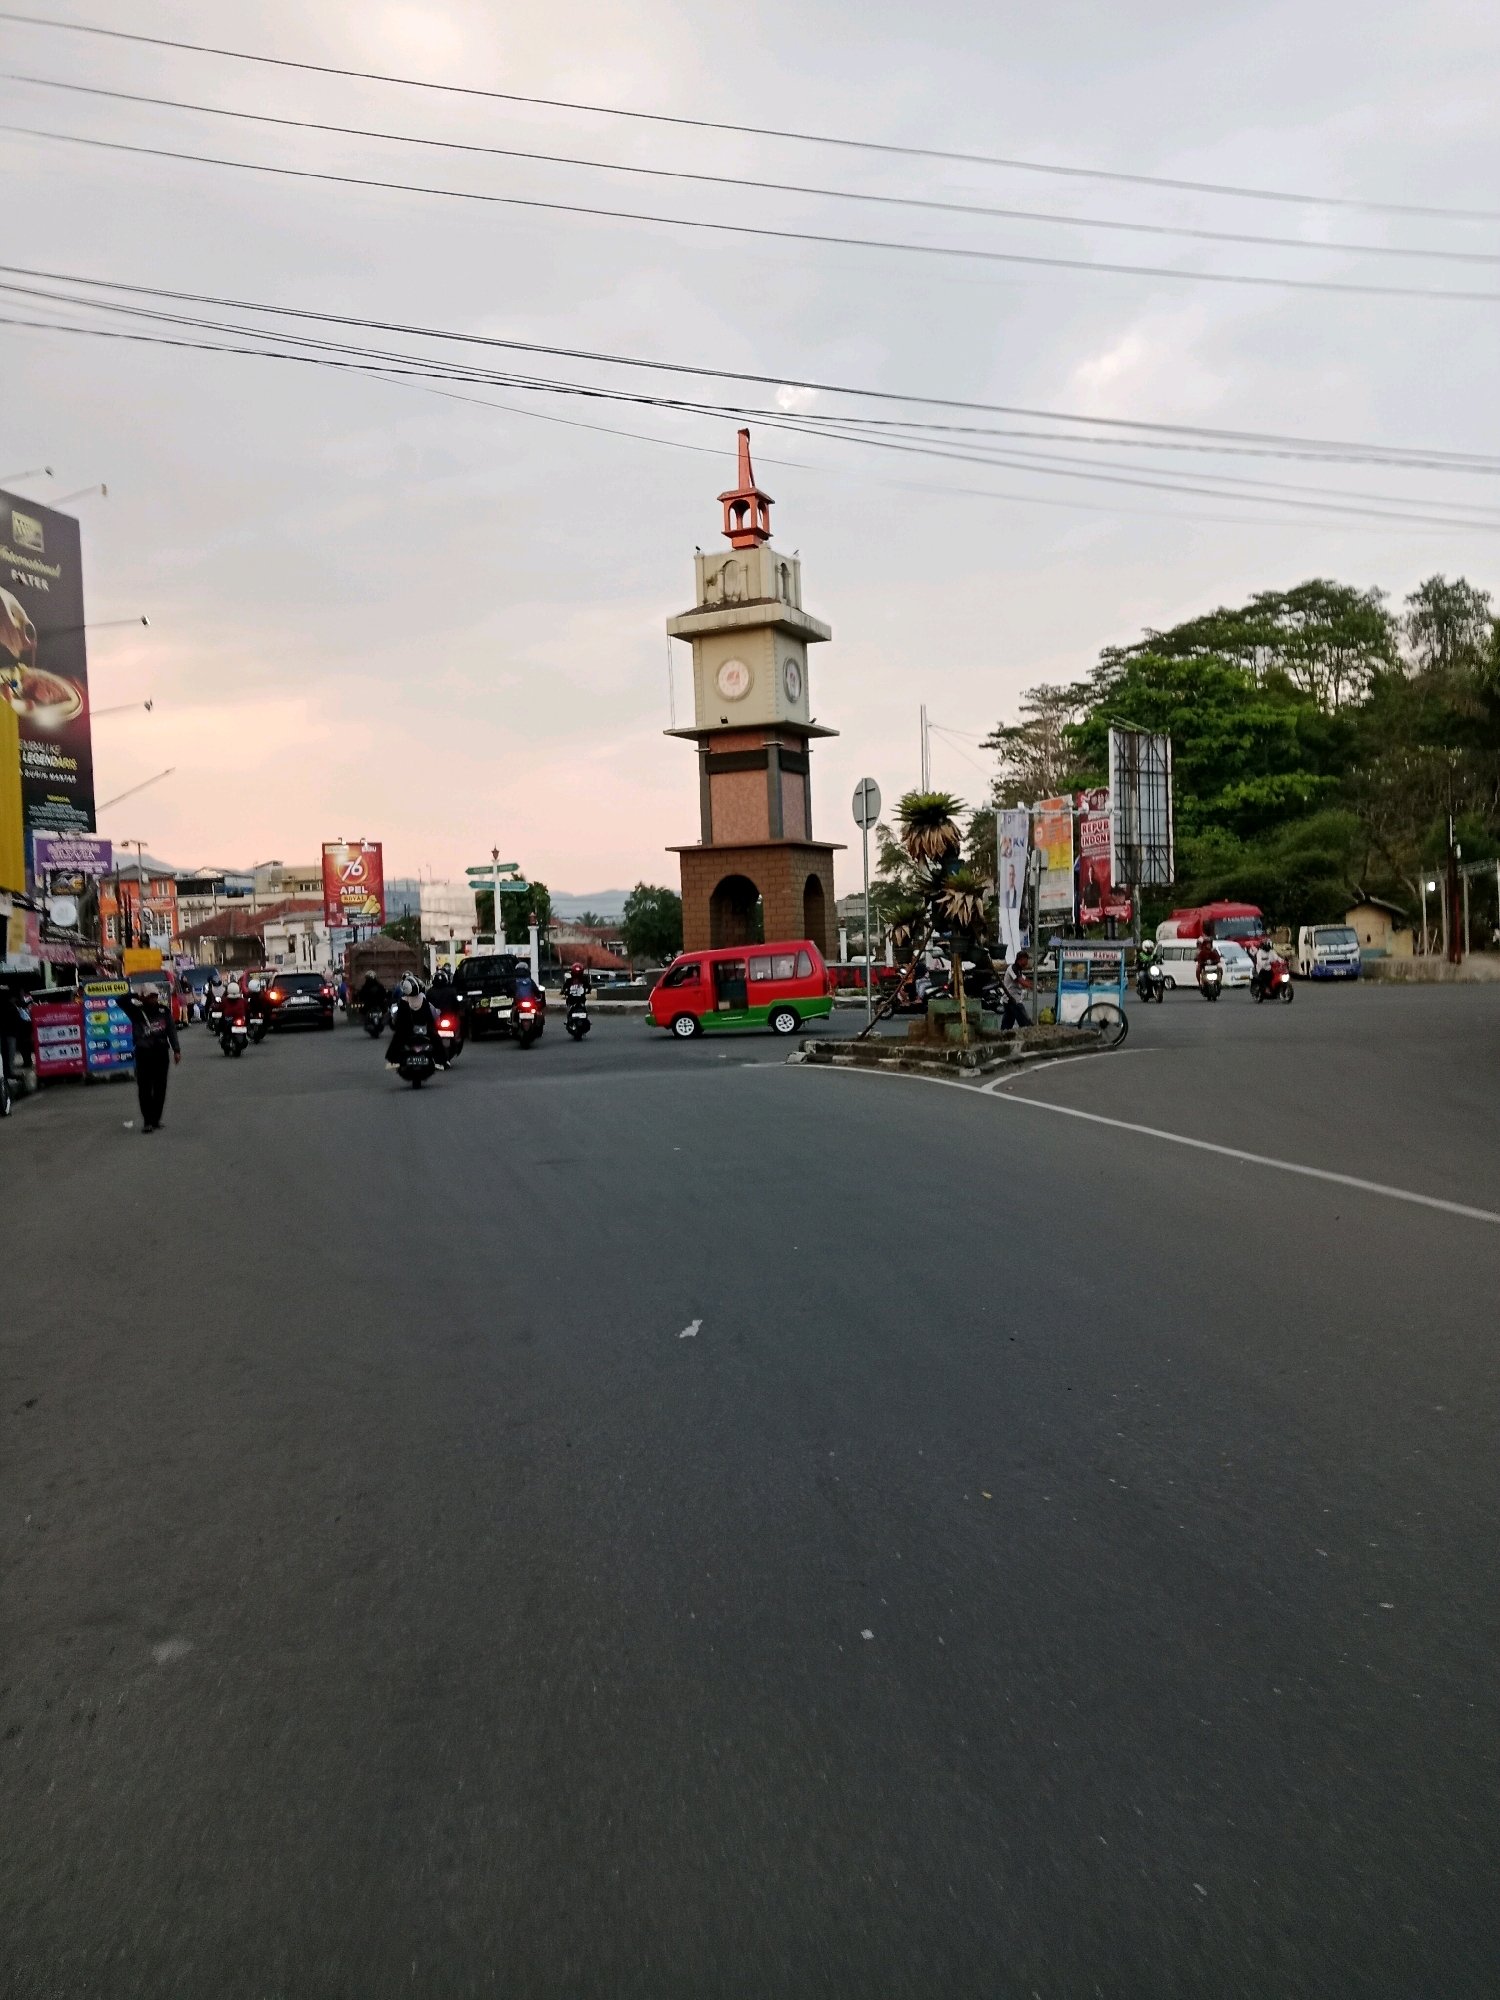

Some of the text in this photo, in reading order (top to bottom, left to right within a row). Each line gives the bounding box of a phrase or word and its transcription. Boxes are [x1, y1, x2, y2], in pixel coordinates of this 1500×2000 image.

[11, 568, 50, 592] FILTER
[341, 855, 363, 882] 76
[340, 885, 368, 895] APEL
